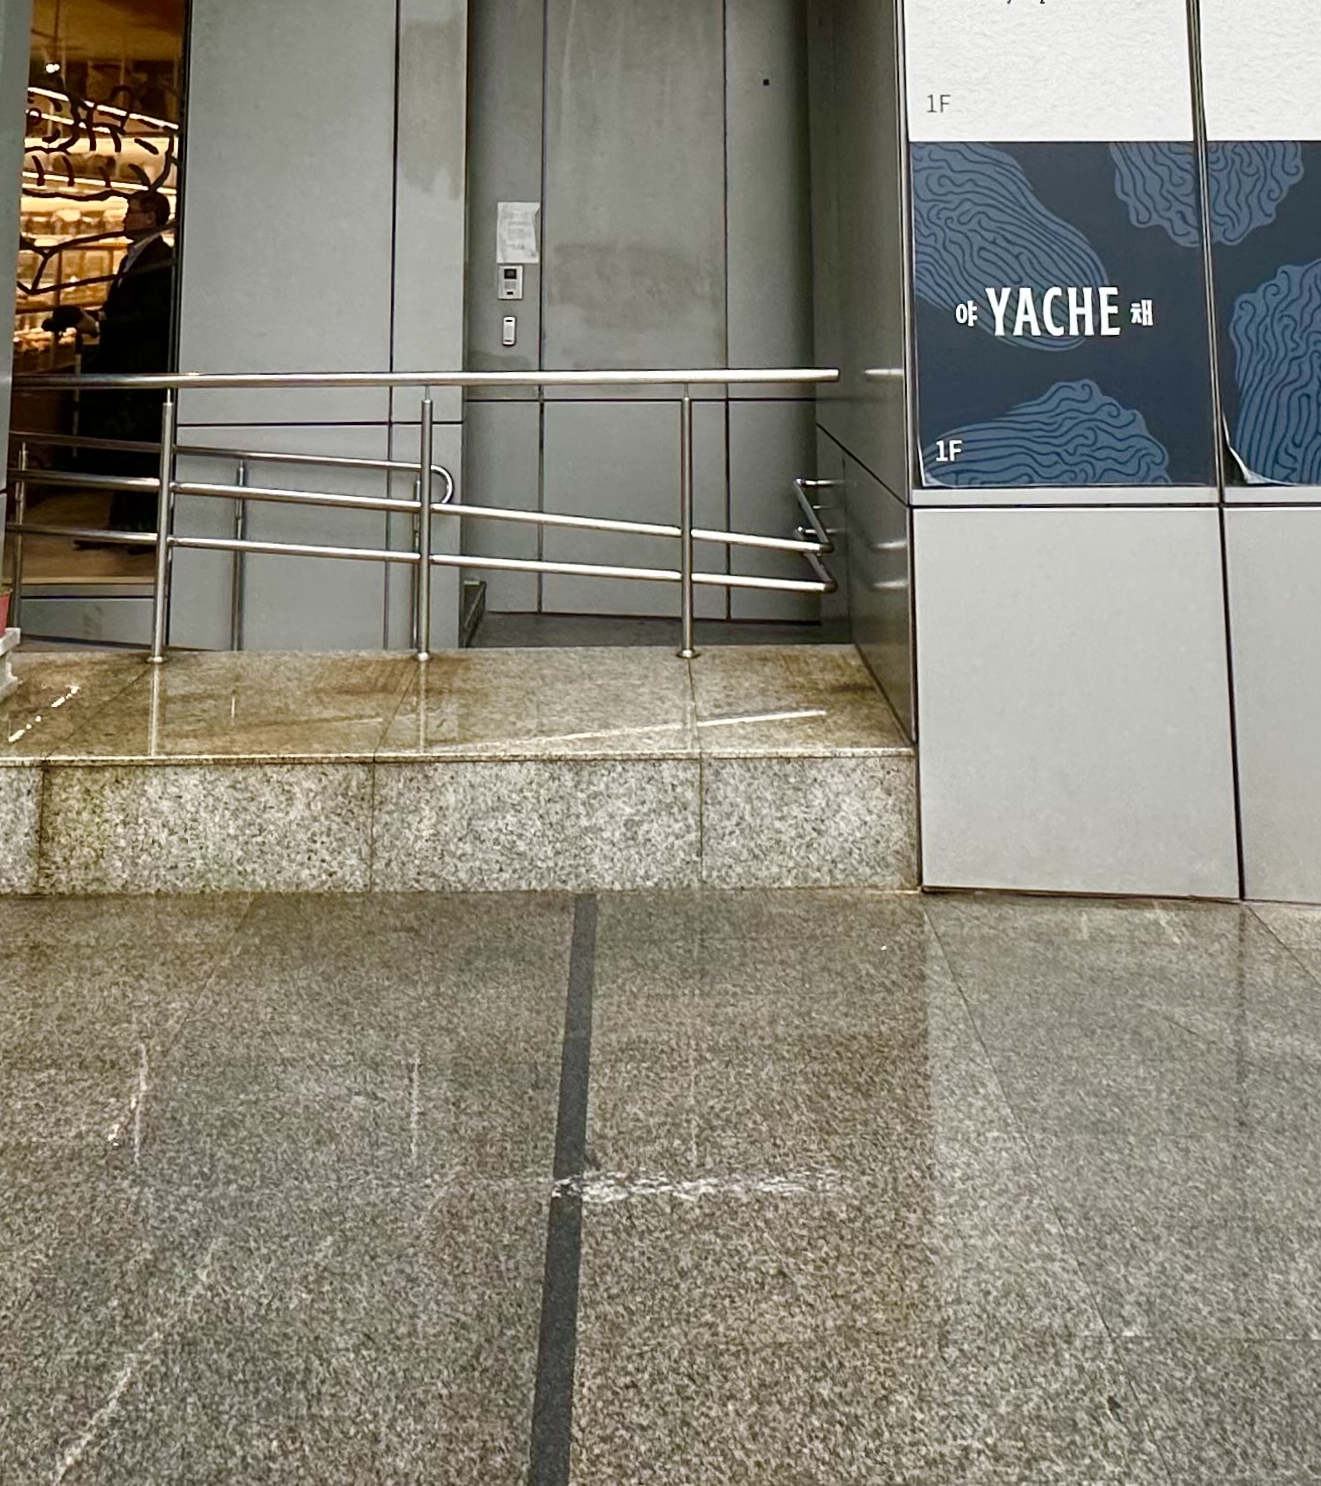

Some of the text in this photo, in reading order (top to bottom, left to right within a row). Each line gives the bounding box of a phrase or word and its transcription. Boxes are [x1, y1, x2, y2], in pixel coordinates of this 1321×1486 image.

[925, 93, 952, 114] 1F
[984, 285, 1121, 337] YACHE
[935, 439, 963, 462] 1F
